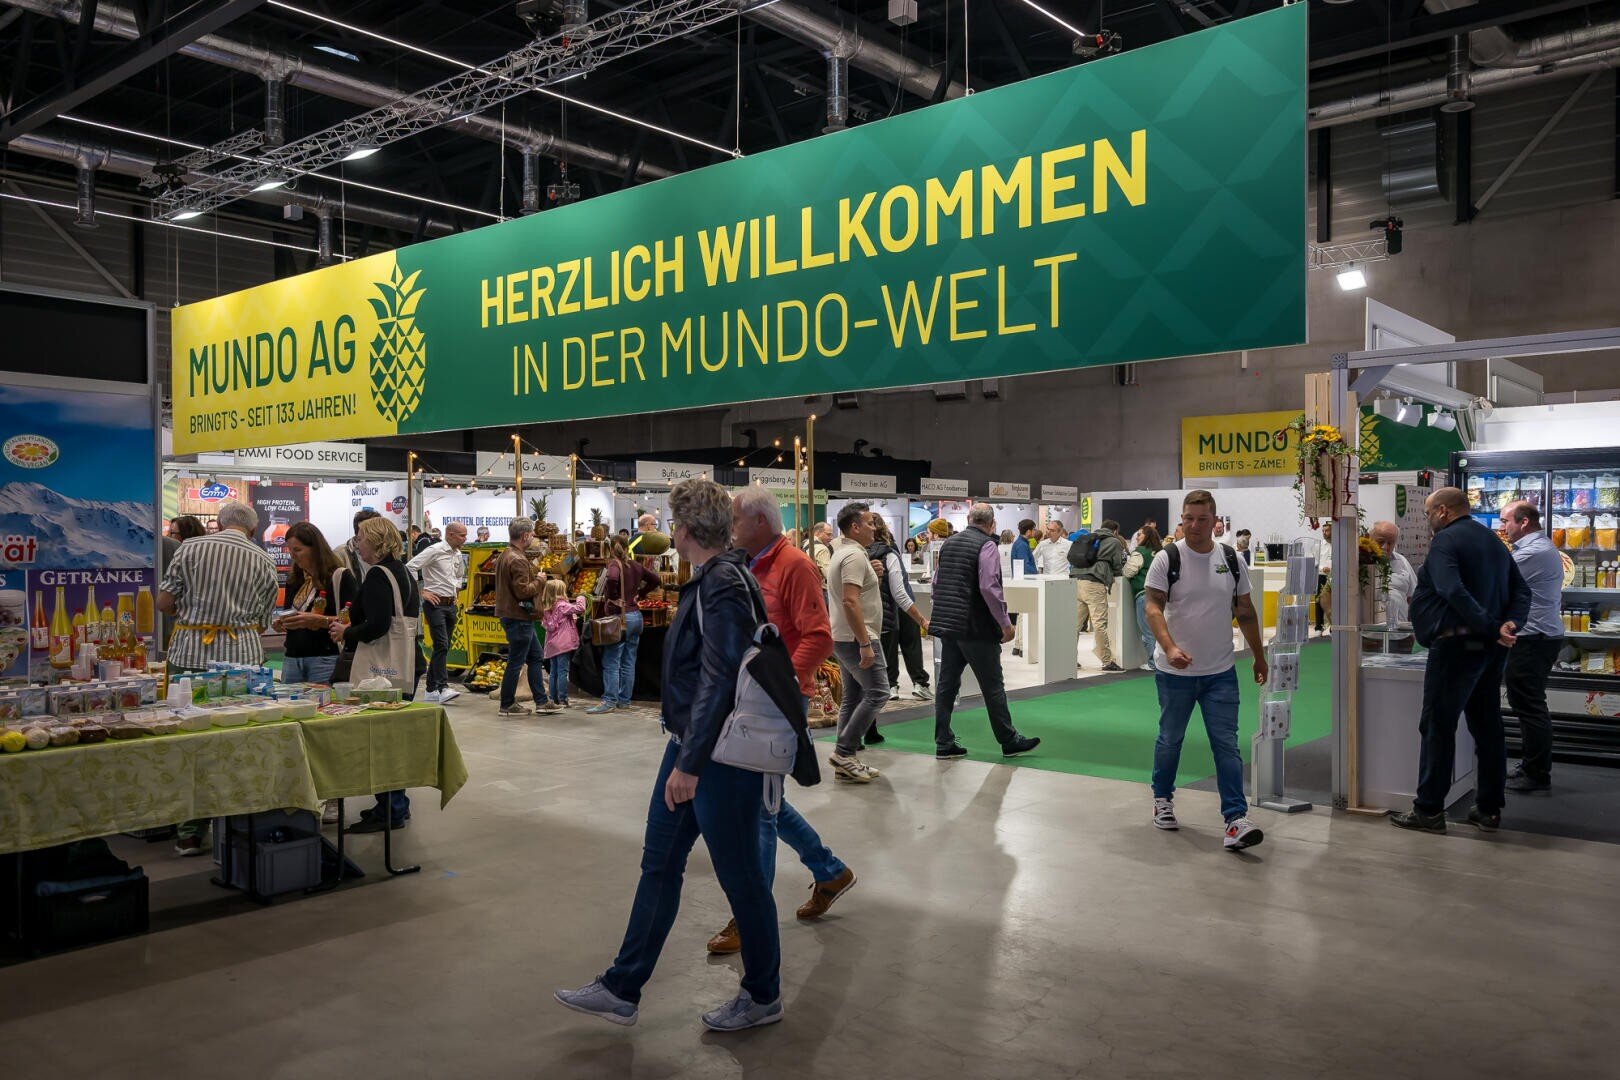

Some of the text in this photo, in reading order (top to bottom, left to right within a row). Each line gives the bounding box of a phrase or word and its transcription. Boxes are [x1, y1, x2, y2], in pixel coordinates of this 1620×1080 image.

[481, 129, 1147, 328] HERZLICH WILLKOMMEN
[513, 252, 1078, 396] IN DER MUNDO-WELT
[189, 314, 356, 397] MUNDO AG
[190, 409, 238, 434] BRINGT'S
[247, 404, 273, 428] SEIT
[276, 401, 295, 424] 133
[297, 393, 356, 421] JAHREN!
[1199, 429, 1288, 455] MUNDO
[238, 448, 364, 463] EMMI FOOD SERVICE
[508, 460, 546, 472] HG AG
[1199, 460, 1244, 471] BRINGT'S
[1254, 457, 1286, 469] ZÄME!
[679, 469, 691, 479] AG
[201, 485, 227, 497] Emmi
[879, 480, 888, 489] AG
[0, 533, 36, 562] ät
[40, 568, 144, 585] GETRÄNKE
[472, 620, 502, 632] MUNDO
